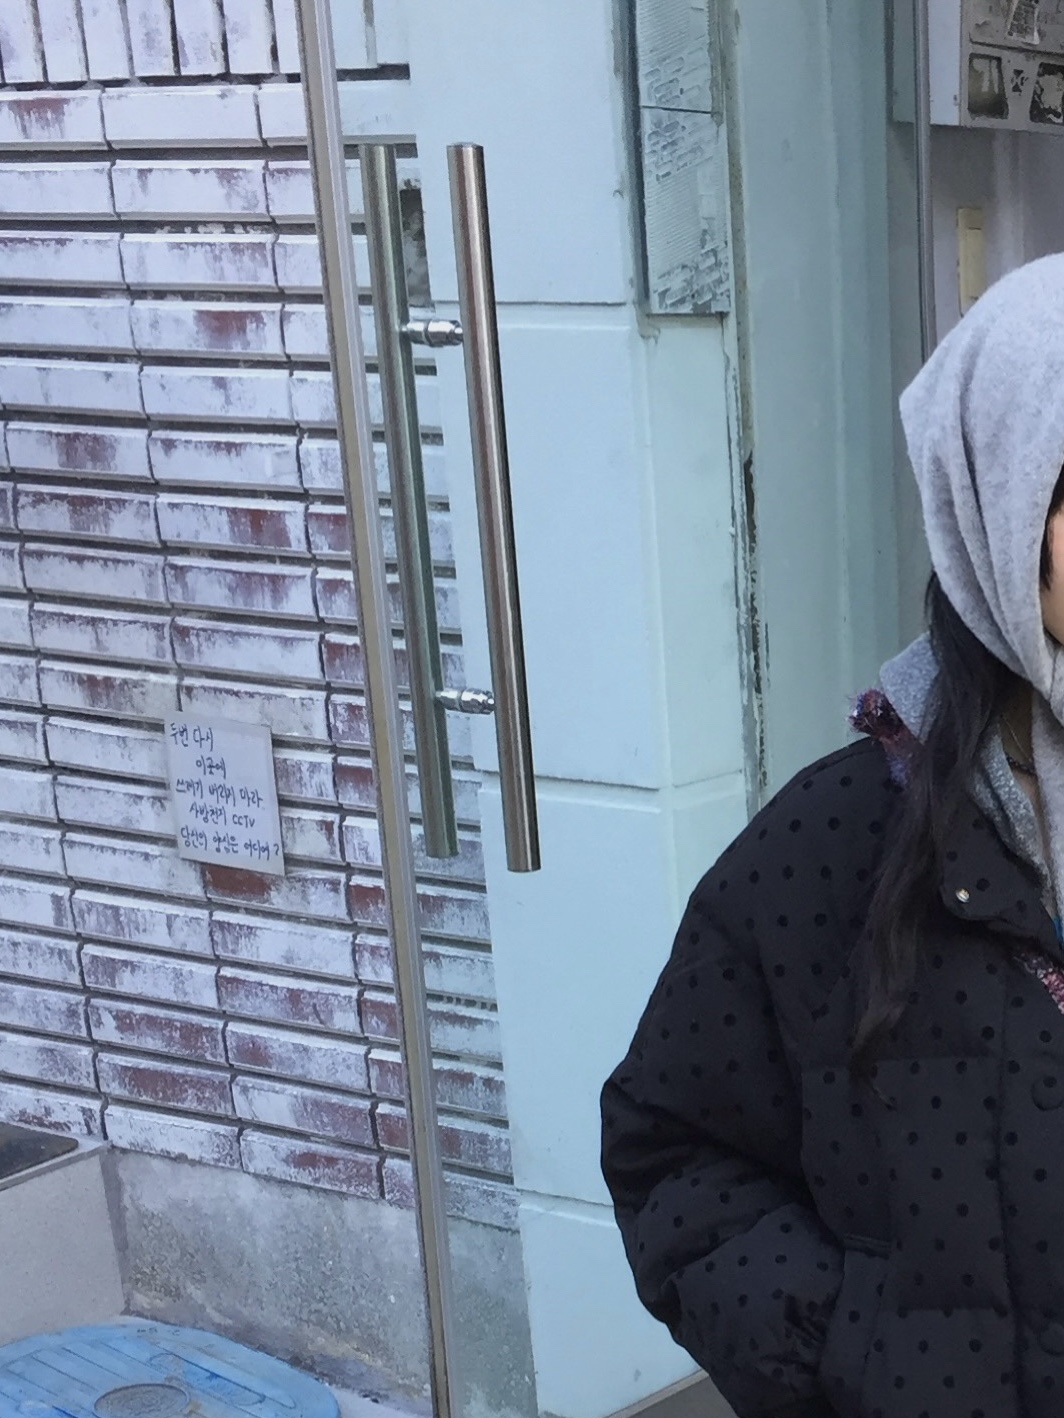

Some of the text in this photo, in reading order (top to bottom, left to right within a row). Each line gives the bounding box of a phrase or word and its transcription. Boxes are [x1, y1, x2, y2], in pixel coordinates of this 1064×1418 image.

[171, 722, 213, 751] 두번 다시
[196, 755, 226, 780] 이곳에
[176, 778, 263, 808] 쓰레기 버리지 마라
[189, 801, 227, 826] 사방천지
[180, 824, 208, 851] 당신의
[213, 830, 239, 854] 양심은
